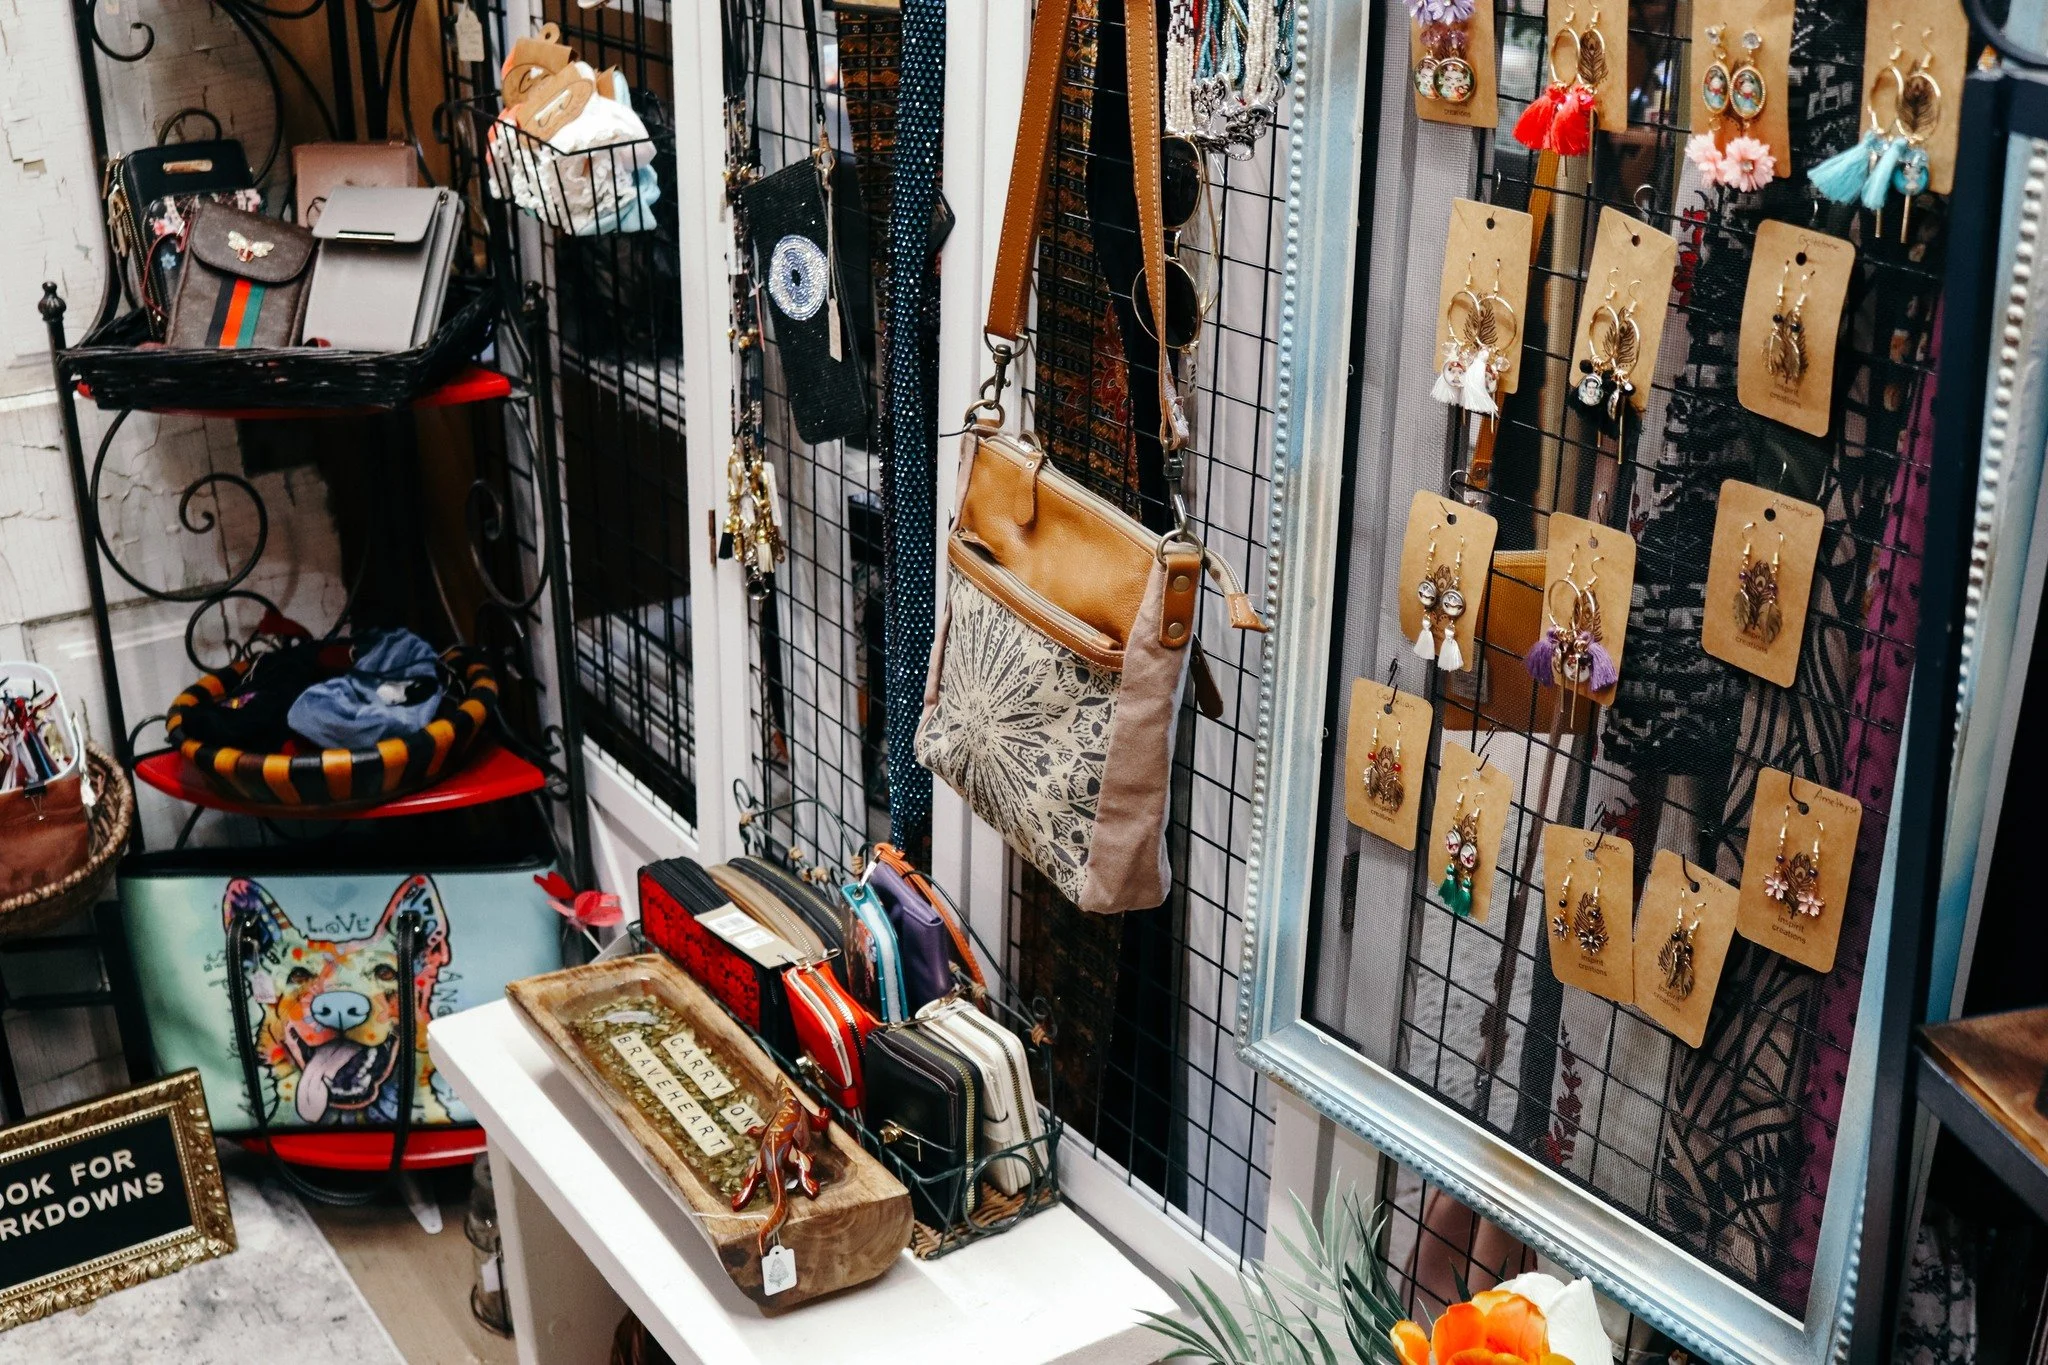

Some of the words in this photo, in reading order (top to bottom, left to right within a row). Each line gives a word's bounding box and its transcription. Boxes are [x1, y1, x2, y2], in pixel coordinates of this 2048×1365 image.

[1771, 924, 1806, 945] creations
[617, 1035, 726, 1149] BRAVEHEART
[669, 1036, 727, 1091] CARRY
[730, 1106, 757, 1128] ON
[0, 1172, 55, 1211] OK
[70, 1148, 136, 1187] FOR
[0, 1171, 165, 1241] RKDOWNS
